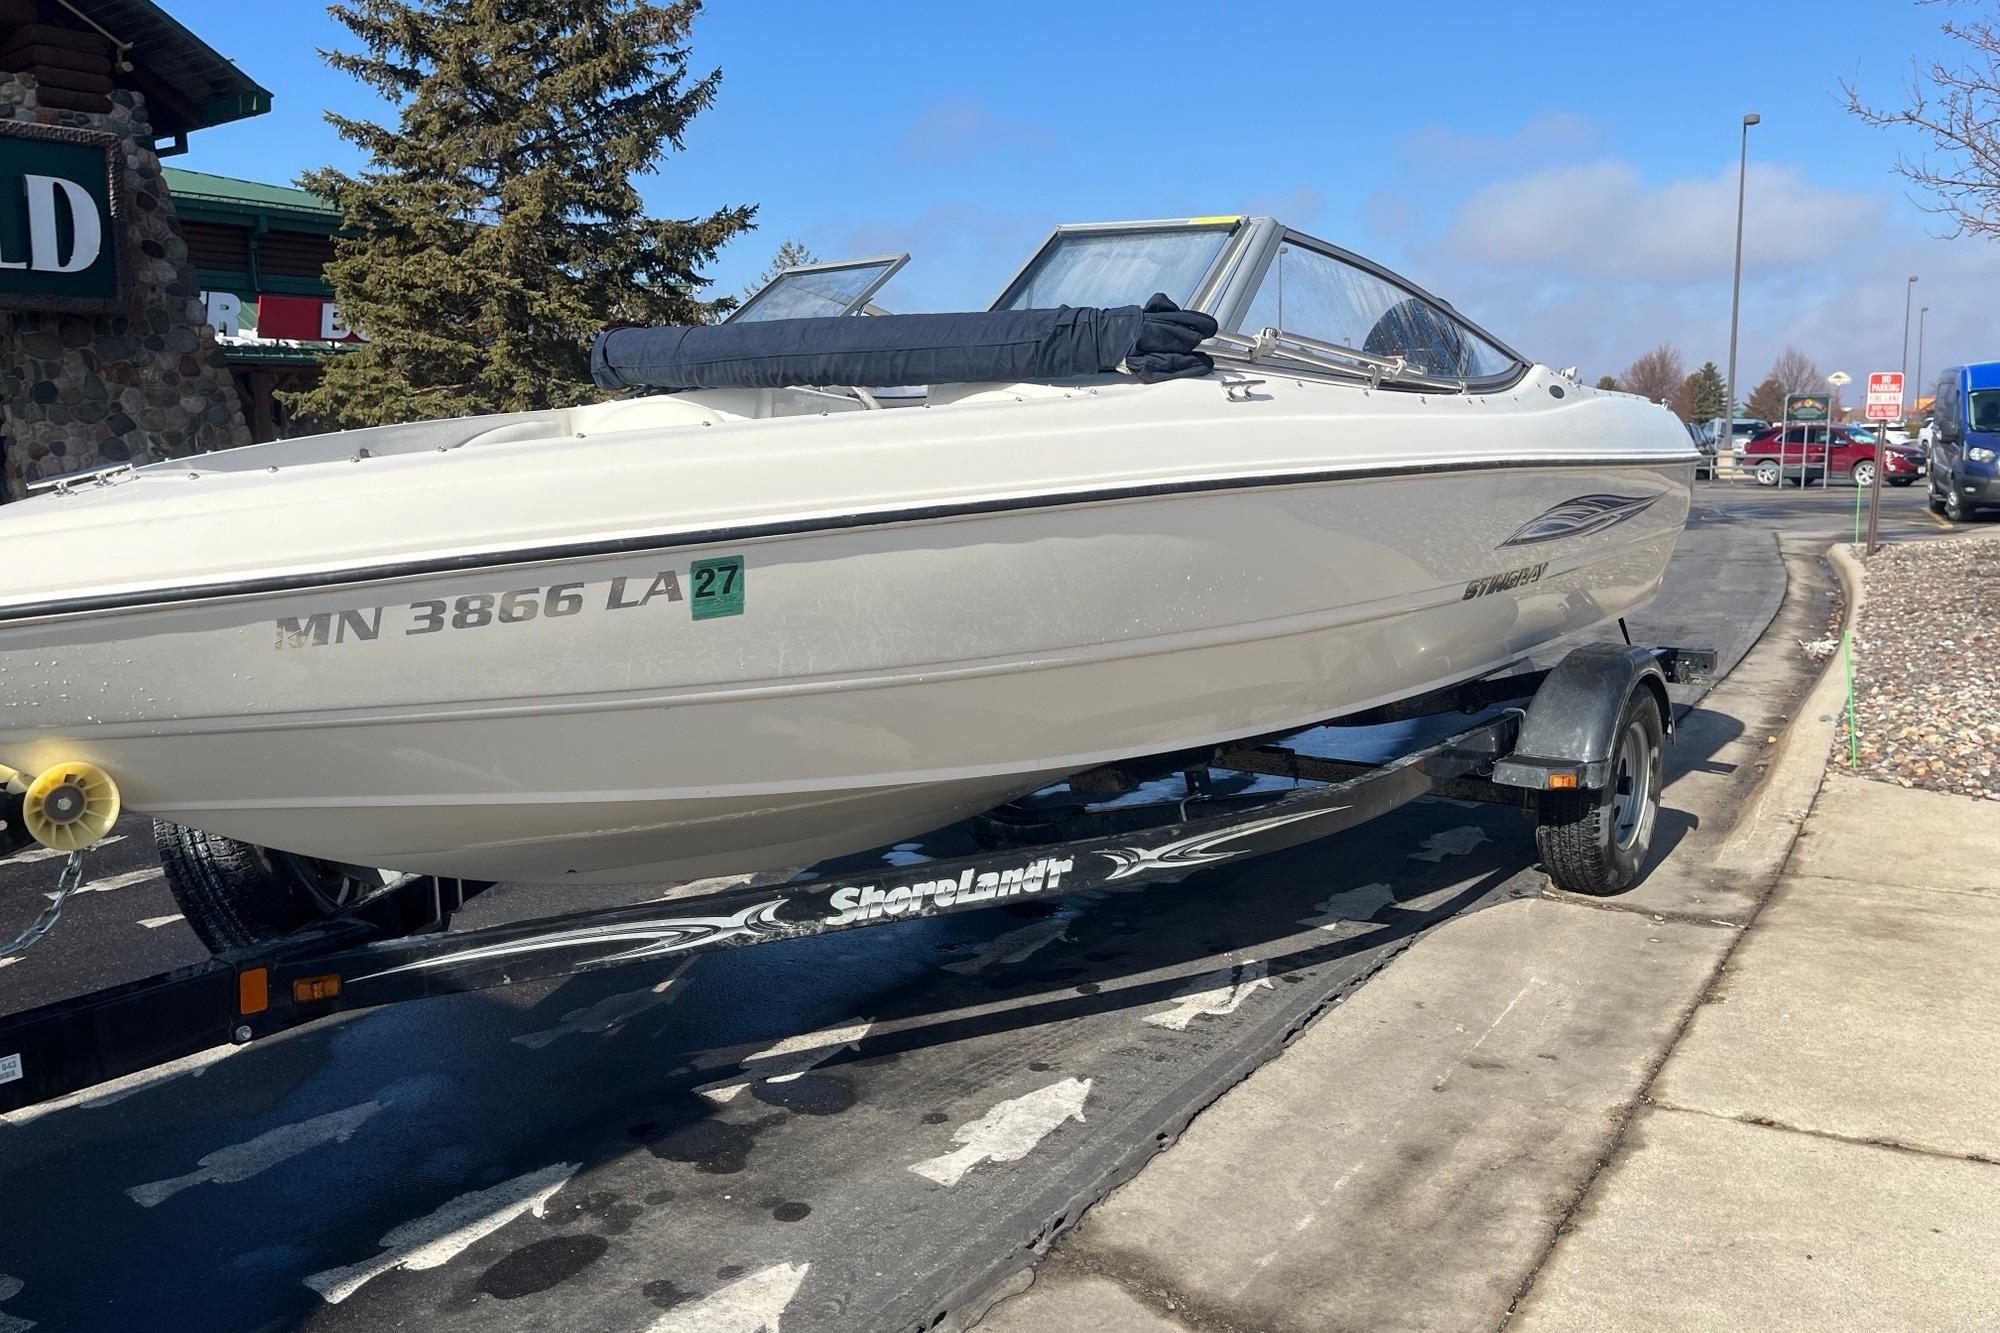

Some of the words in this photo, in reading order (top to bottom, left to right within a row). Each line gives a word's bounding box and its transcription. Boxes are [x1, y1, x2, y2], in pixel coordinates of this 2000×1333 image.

[1871, 383, 1900, 392] PARKING
[1881, 375, 1892, 384] NO
[695, 564, 738, 599] 27
[274, 606, 383, 650] MN
[406, 582, 585, 636] 3866
[606, 570, 684, 610] LA
